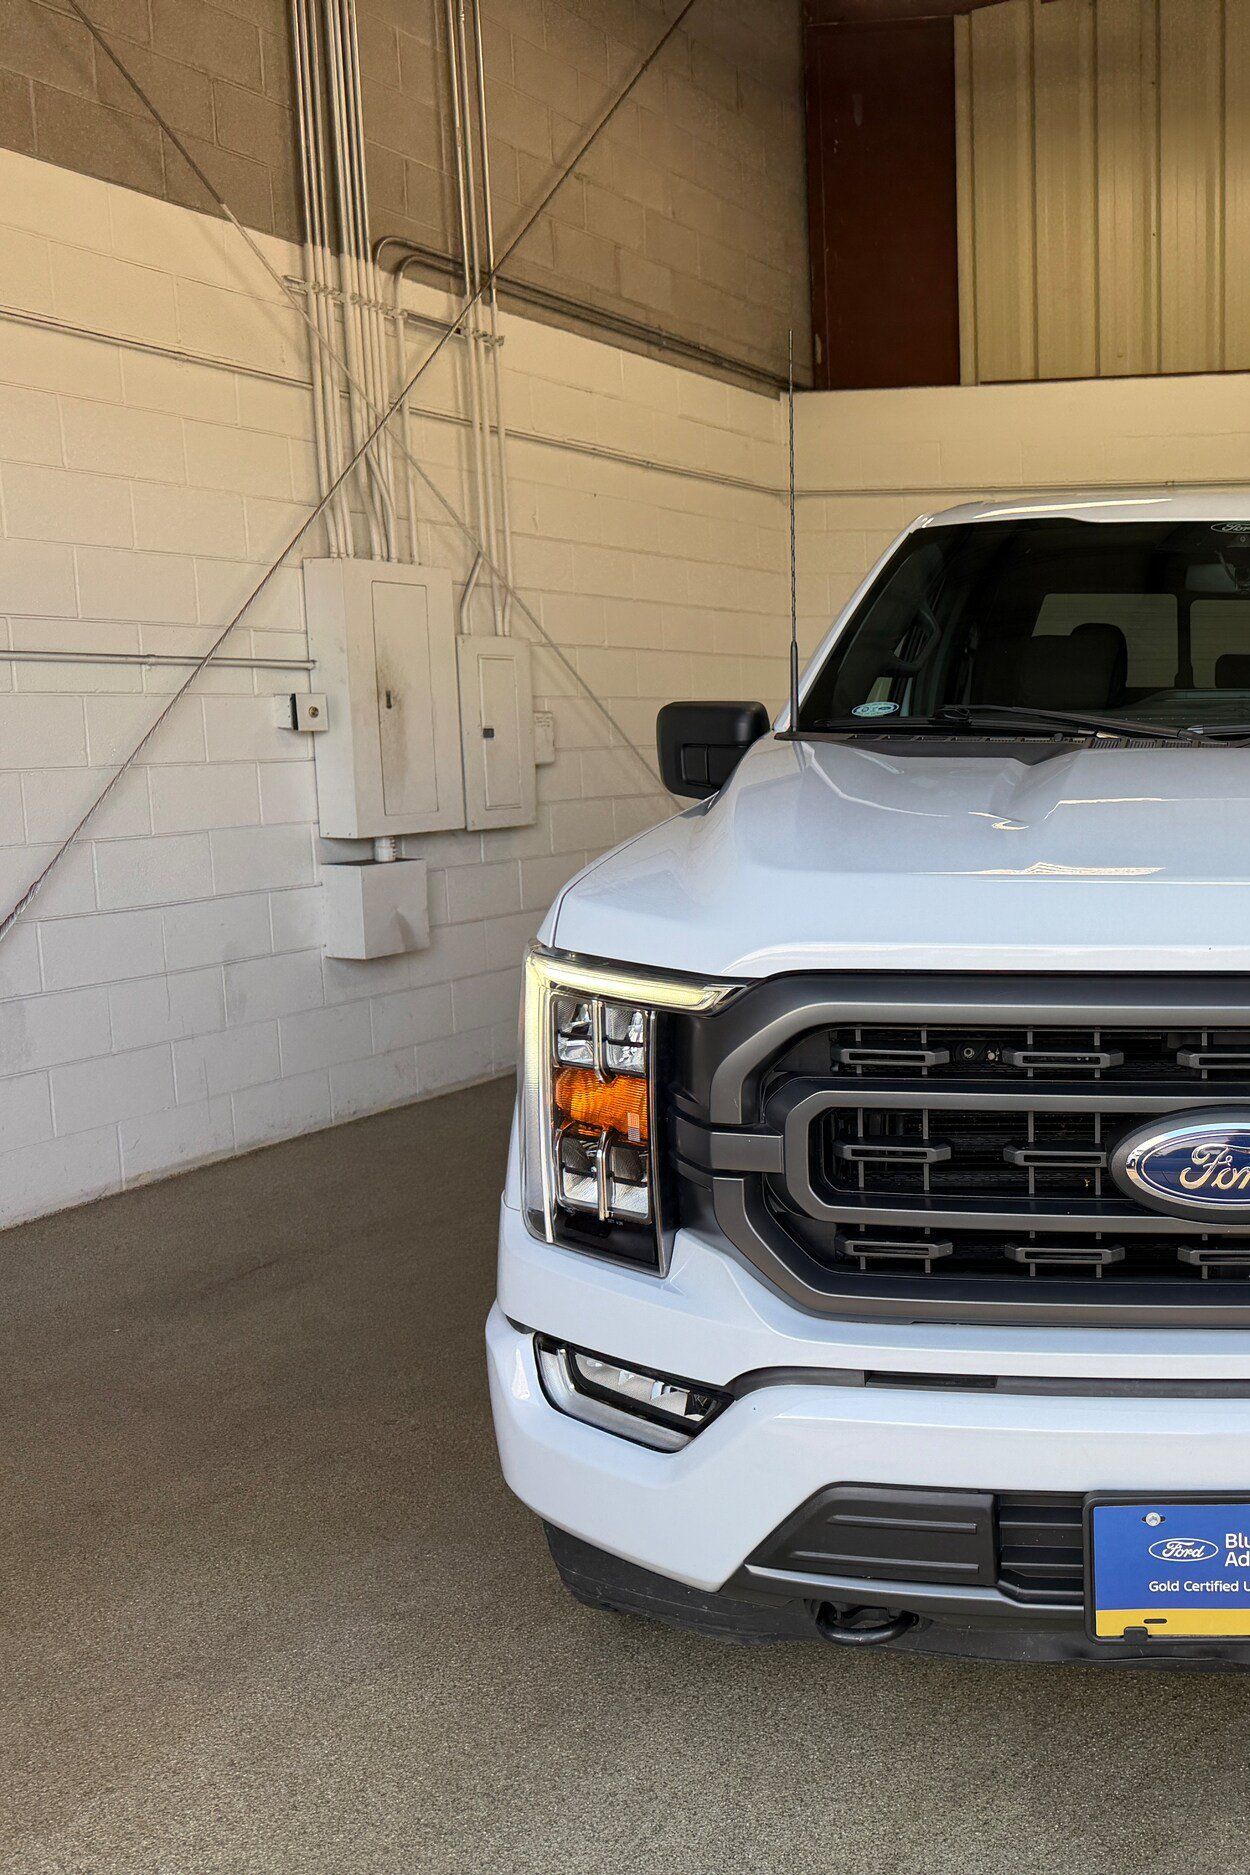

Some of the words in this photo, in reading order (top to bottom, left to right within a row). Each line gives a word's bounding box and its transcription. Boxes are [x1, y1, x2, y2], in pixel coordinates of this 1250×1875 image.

[1161, 1540, 1205, 1558] Ford
[1149, 1581, 1180, 1592] Gold
[1183, 1580, 1239, 1592] Certified
